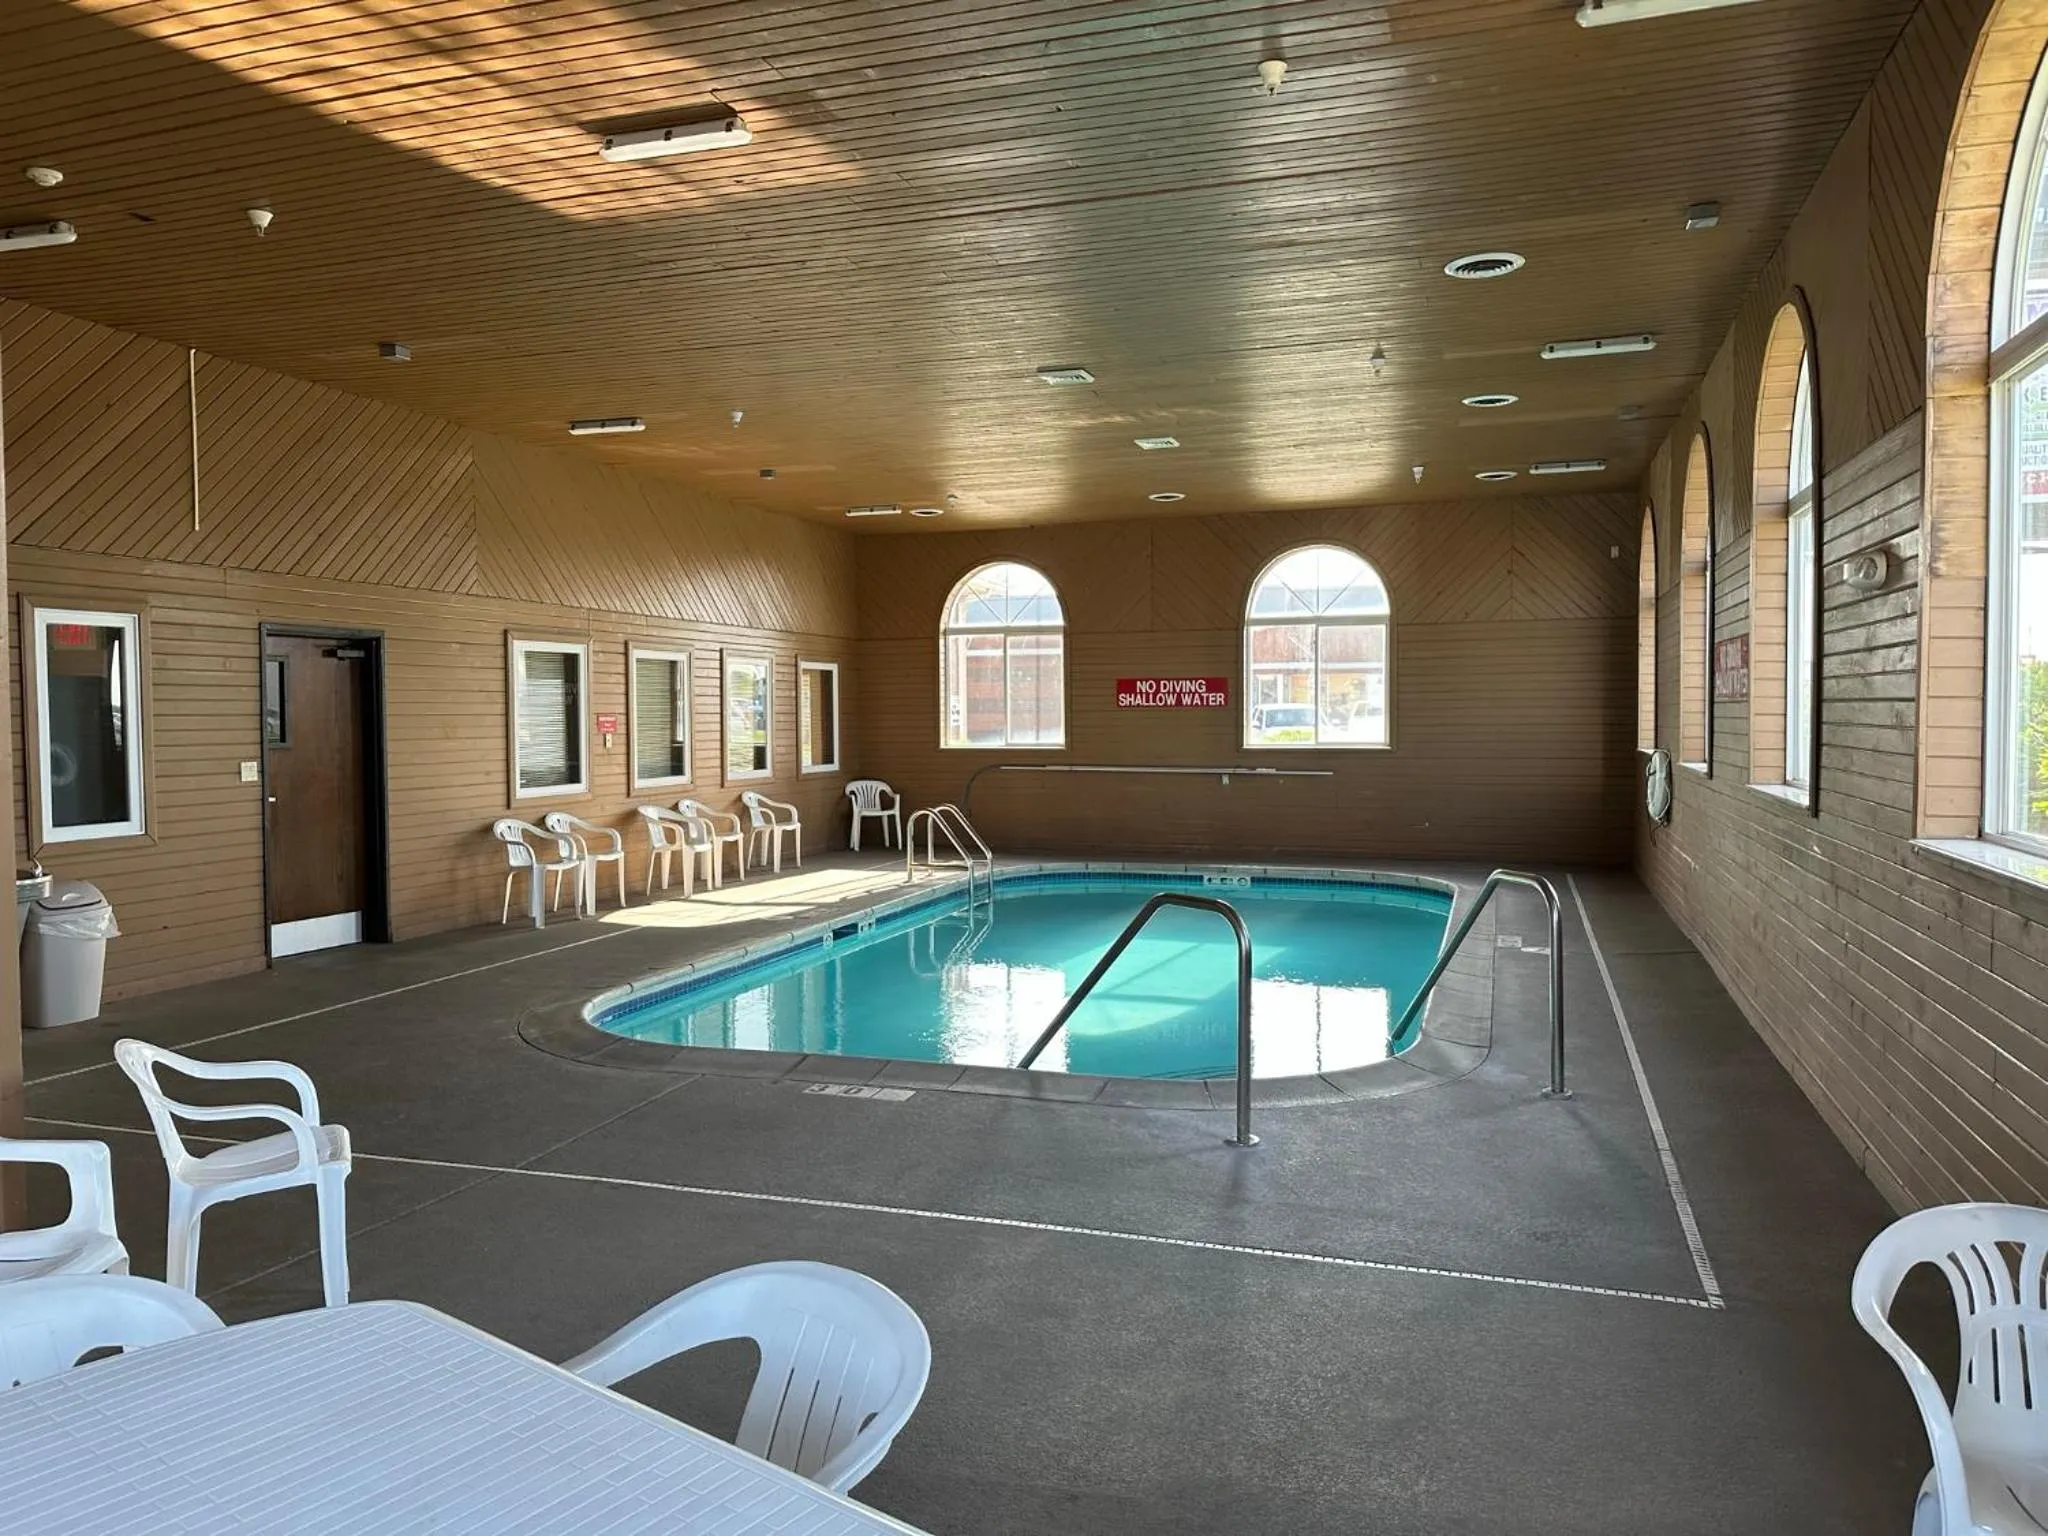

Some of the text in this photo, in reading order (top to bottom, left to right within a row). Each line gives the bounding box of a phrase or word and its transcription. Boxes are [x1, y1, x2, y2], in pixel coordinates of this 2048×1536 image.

[1136, 680, 1207, 693] NO DIVING
[1118, 693, 1225, 706] SHALLOW WATER
